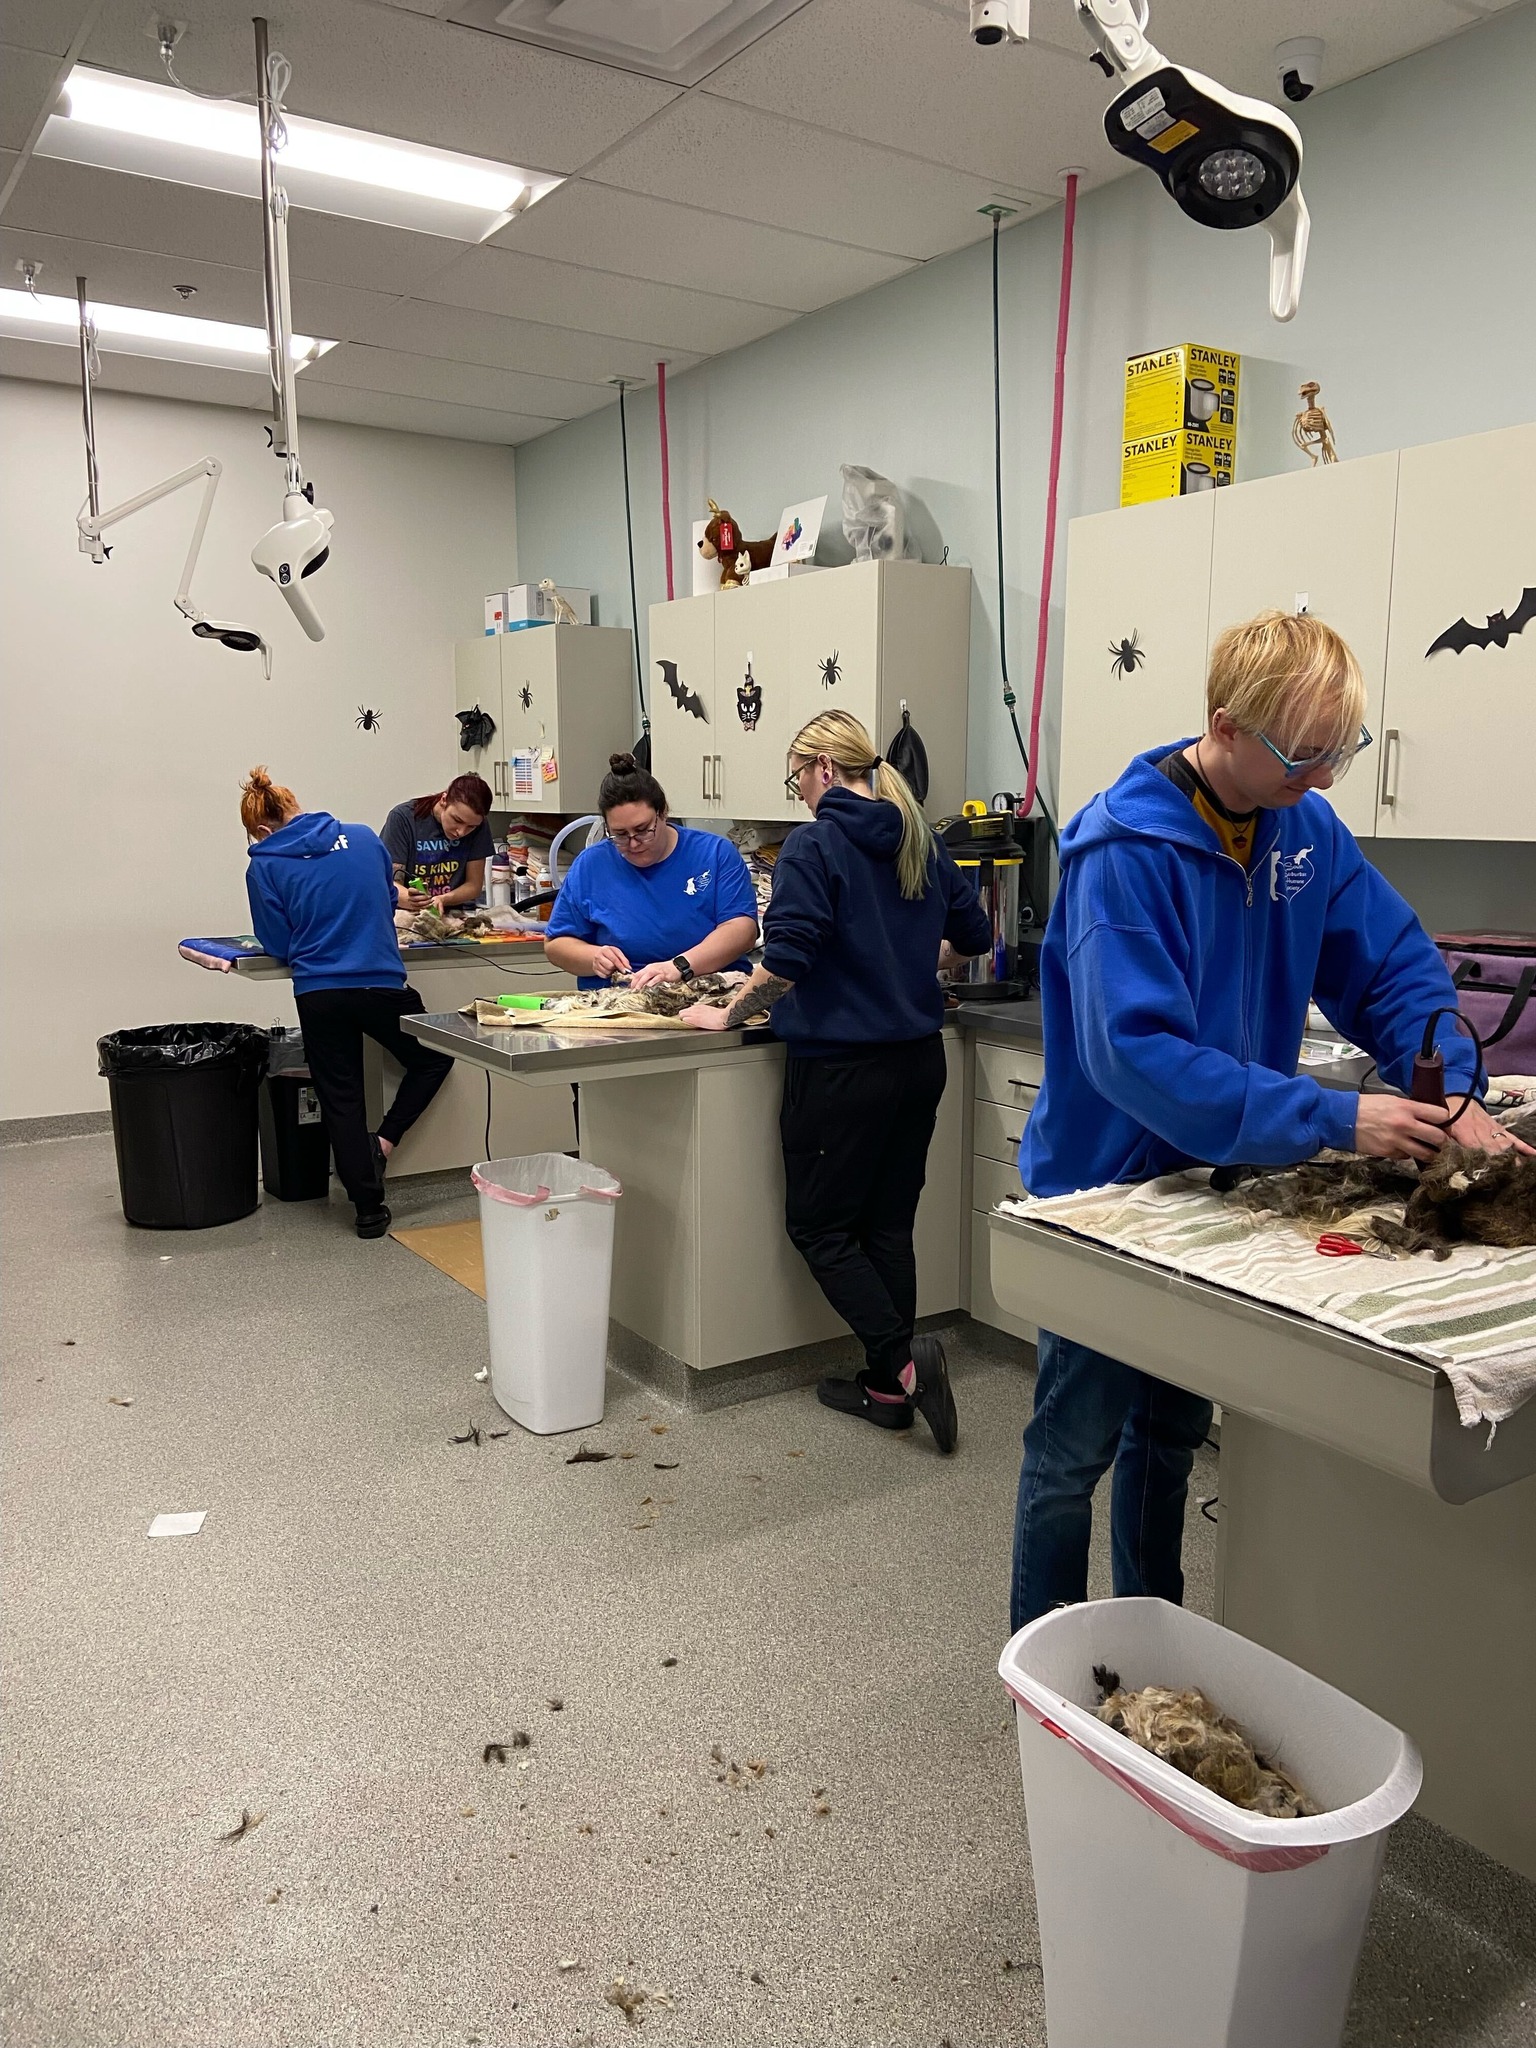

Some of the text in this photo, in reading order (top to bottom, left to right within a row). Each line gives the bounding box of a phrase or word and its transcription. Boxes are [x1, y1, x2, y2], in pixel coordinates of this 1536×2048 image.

[1127, 351, 1180, 376] STANLEY
[1191, 348, 1236, 368] STANLEY
[1124, 435, 1177, 458] STANLEY
[1186, 432, 1232, 450] STANLEY
[415, 861, 459, 875] IS KIND
[434, 874, 452, 885] MY
